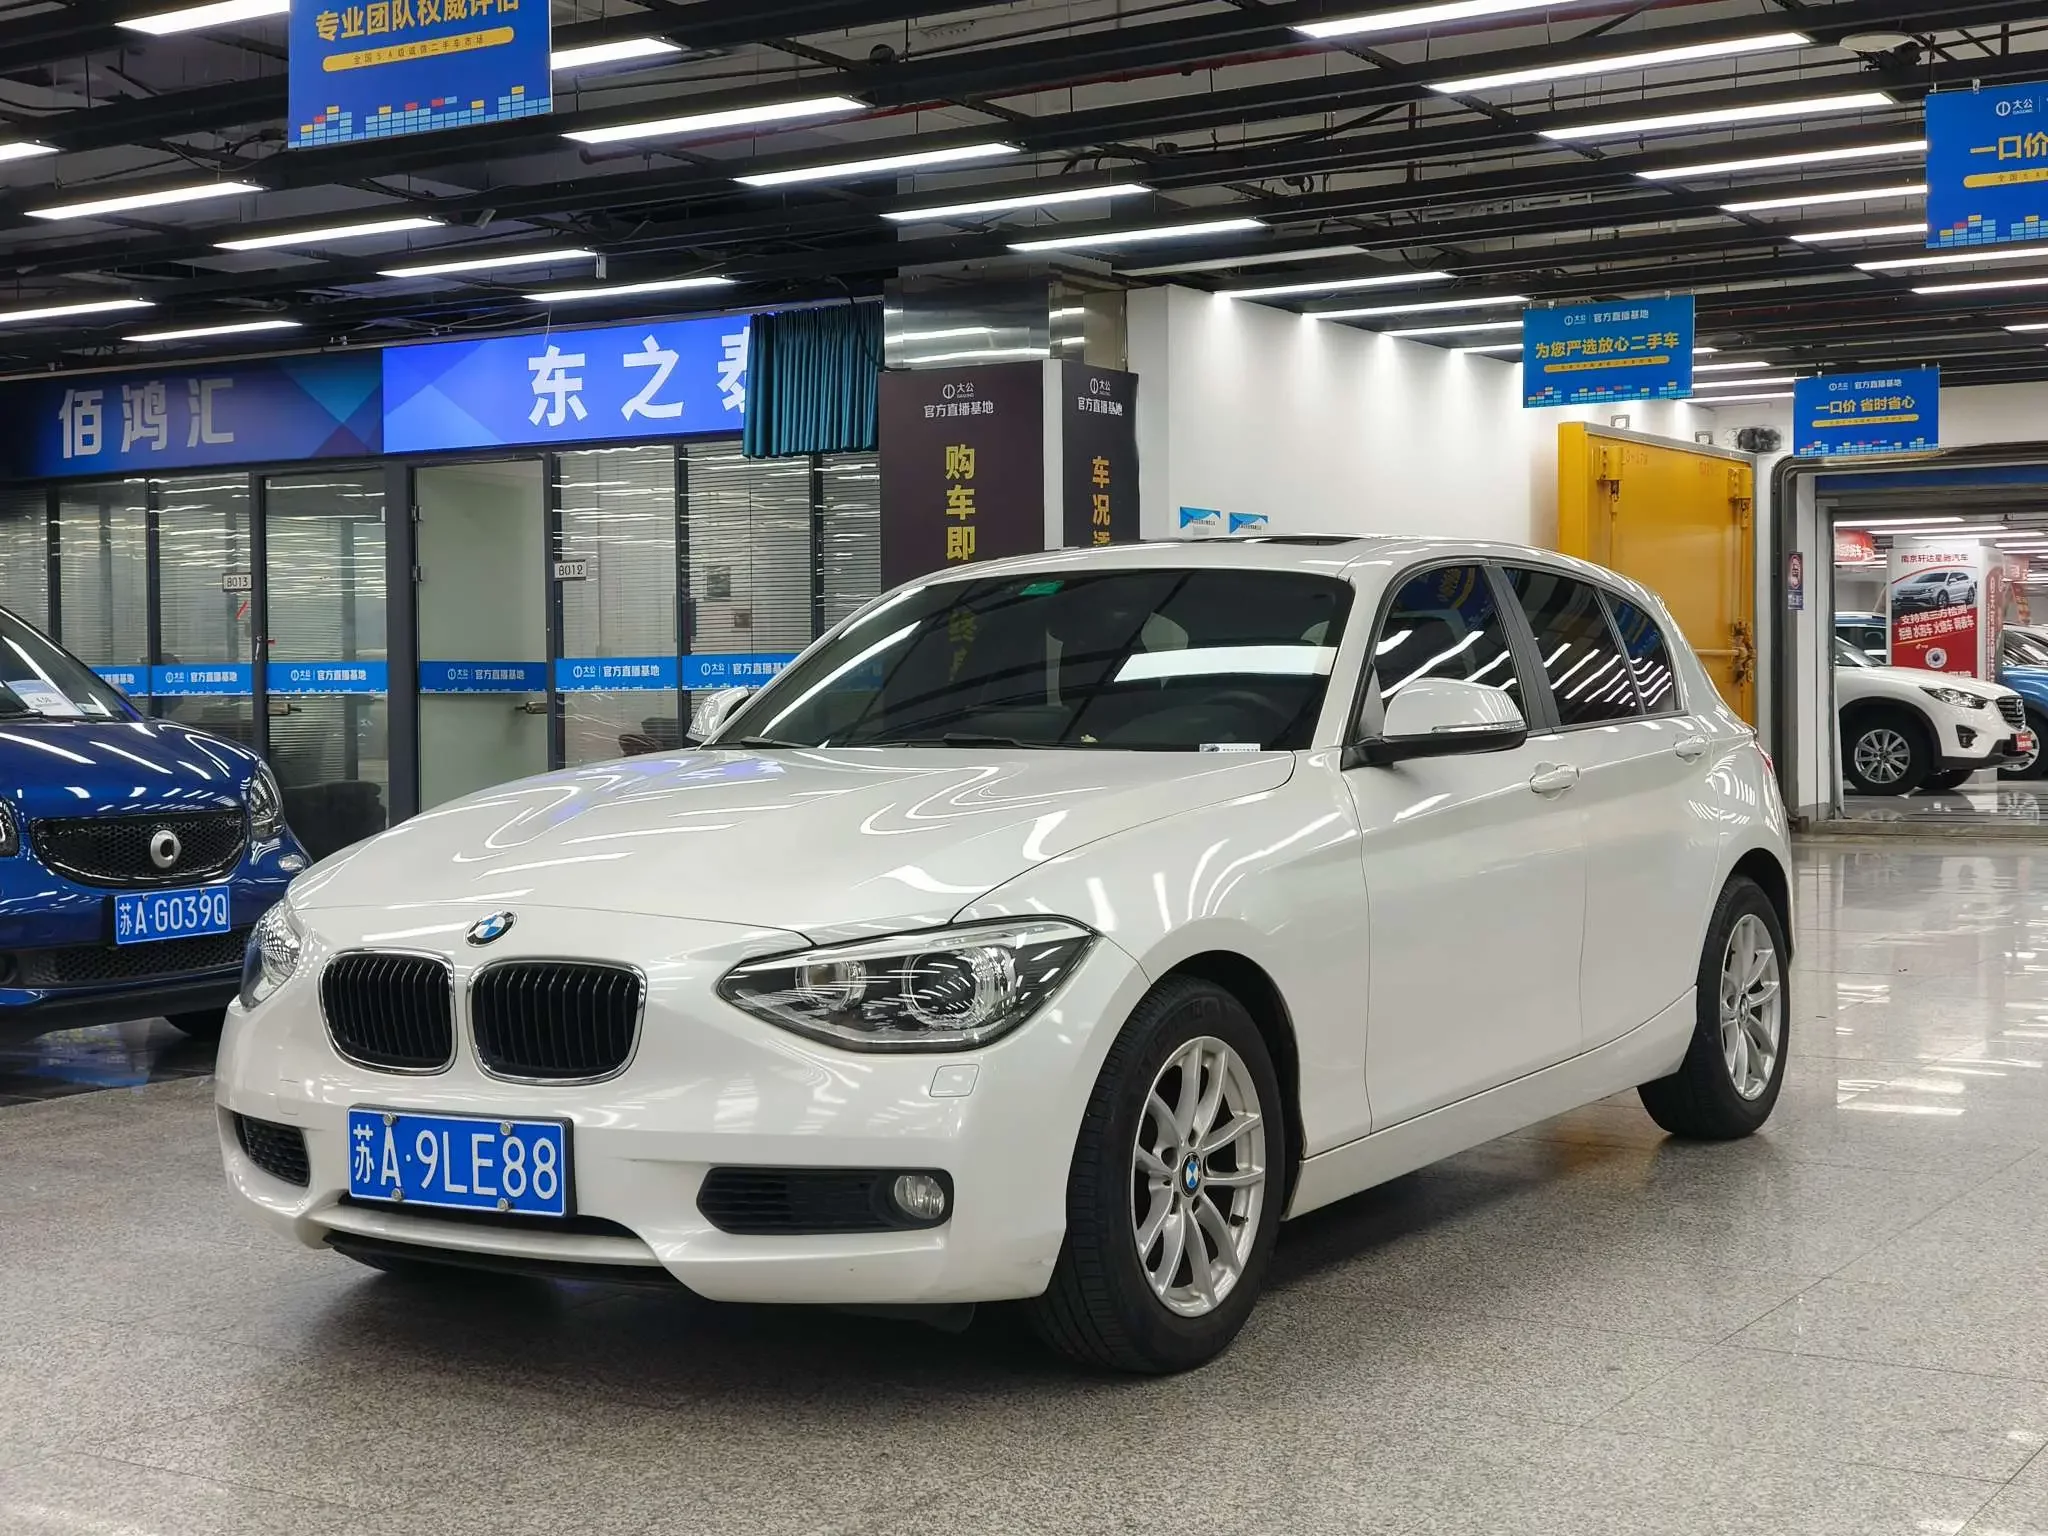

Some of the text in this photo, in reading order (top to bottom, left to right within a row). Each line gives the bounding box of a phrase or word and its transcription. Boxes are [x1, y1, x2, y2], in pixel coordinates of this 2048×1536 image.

[2012, 98, 2033, 110] 大公
[1535, 331, 1680, 359] 为您严选放心二手车
[956, 382, 975, 394] 大公
[1099, 380, 1111, 391] 大公
[923, 400, 994, 418] 官方直播基地
[1077, 396, 1123, 416] 官方直播基地
[1815, 395, 1915, 413] 一口价 省时省心
[58, 377, 235, 458] 佰鸿汇
[583, 665, 660, 677] 大公 官方直播基地
